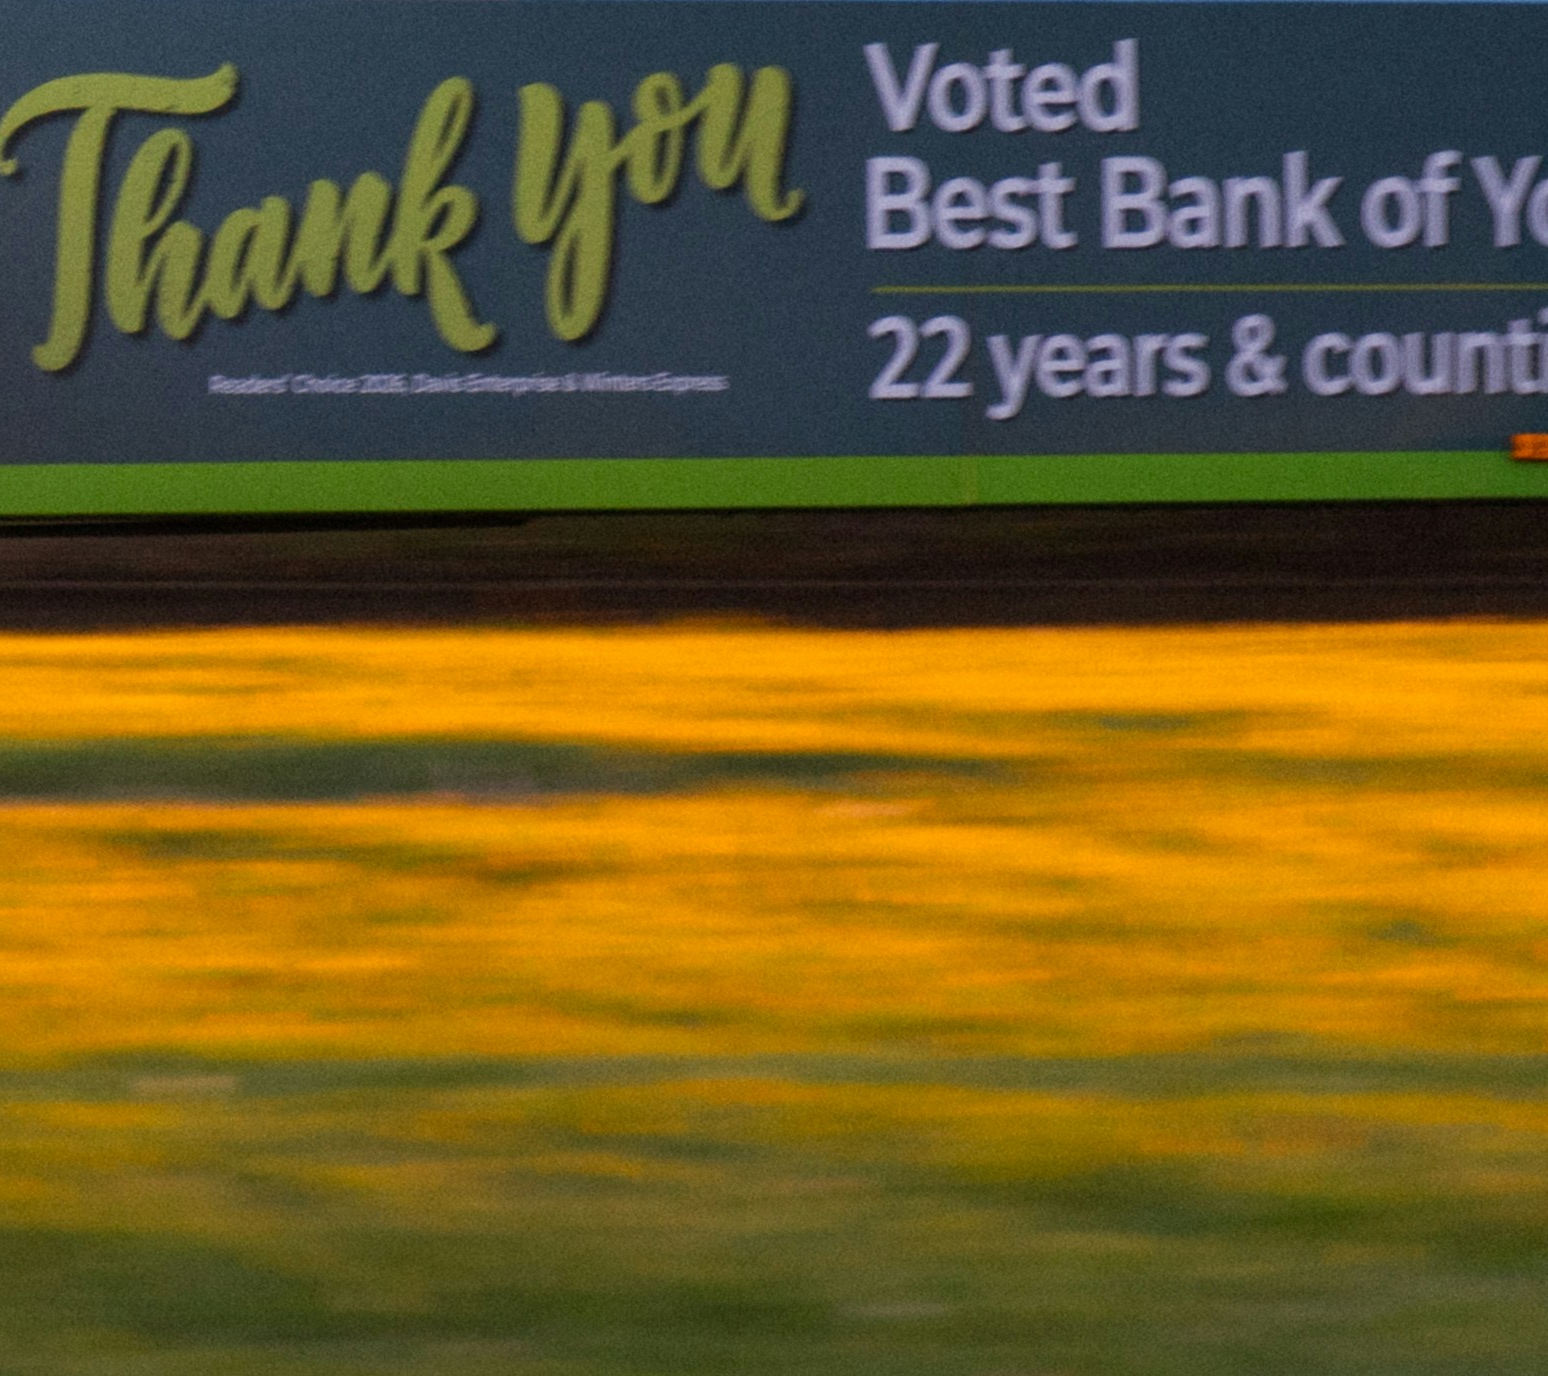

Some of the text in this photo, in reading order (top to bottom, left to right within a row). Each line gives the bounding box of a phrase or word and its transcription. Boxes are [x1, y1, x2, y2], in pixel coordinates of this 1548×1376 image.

[863, 38, 1140, 132] Voted
[866, 155, 1077, 249] Best
[1100, 150, 1346, 249] Bank
[1360, 149, 1463, 248] of
[867, 315, 974, 400] 22
[984, 331, 1211, 420] years
[1224, 313, 1287, 397] &
